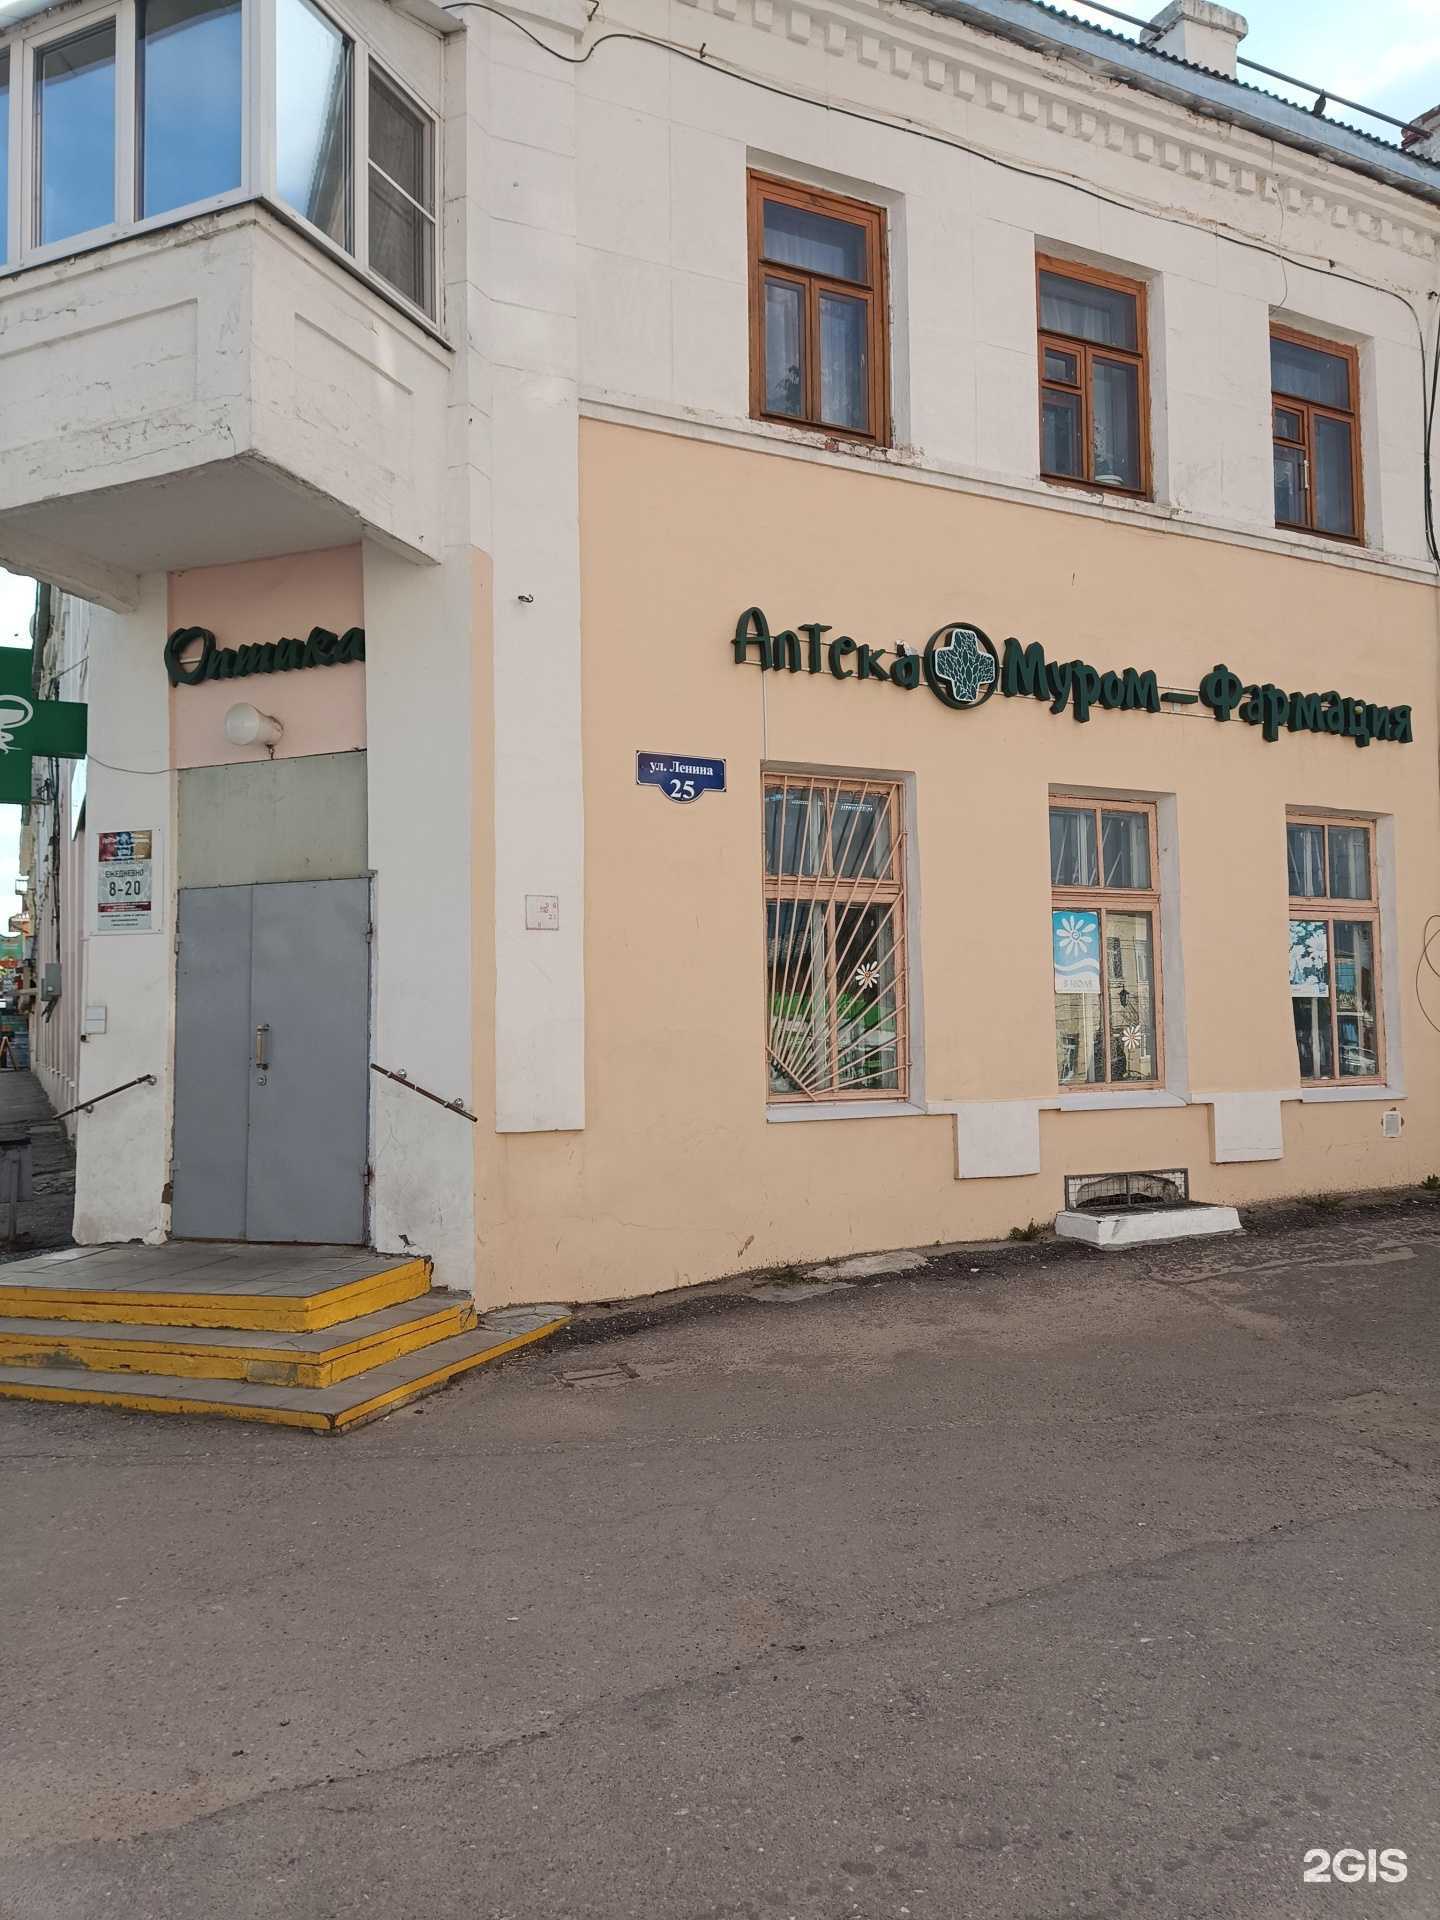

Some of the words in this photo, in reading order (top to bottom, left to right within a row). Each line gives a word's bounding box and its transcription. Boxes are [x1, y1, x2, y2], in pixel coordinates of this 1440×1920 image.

[164, 626, 366, 688] Оптика
[649, 761, 667, 774] ул.
[669, 761, 714, 776] Ленина
[669, 778, 696, 799] 25
[109, 880, 141, 896] 8-20
